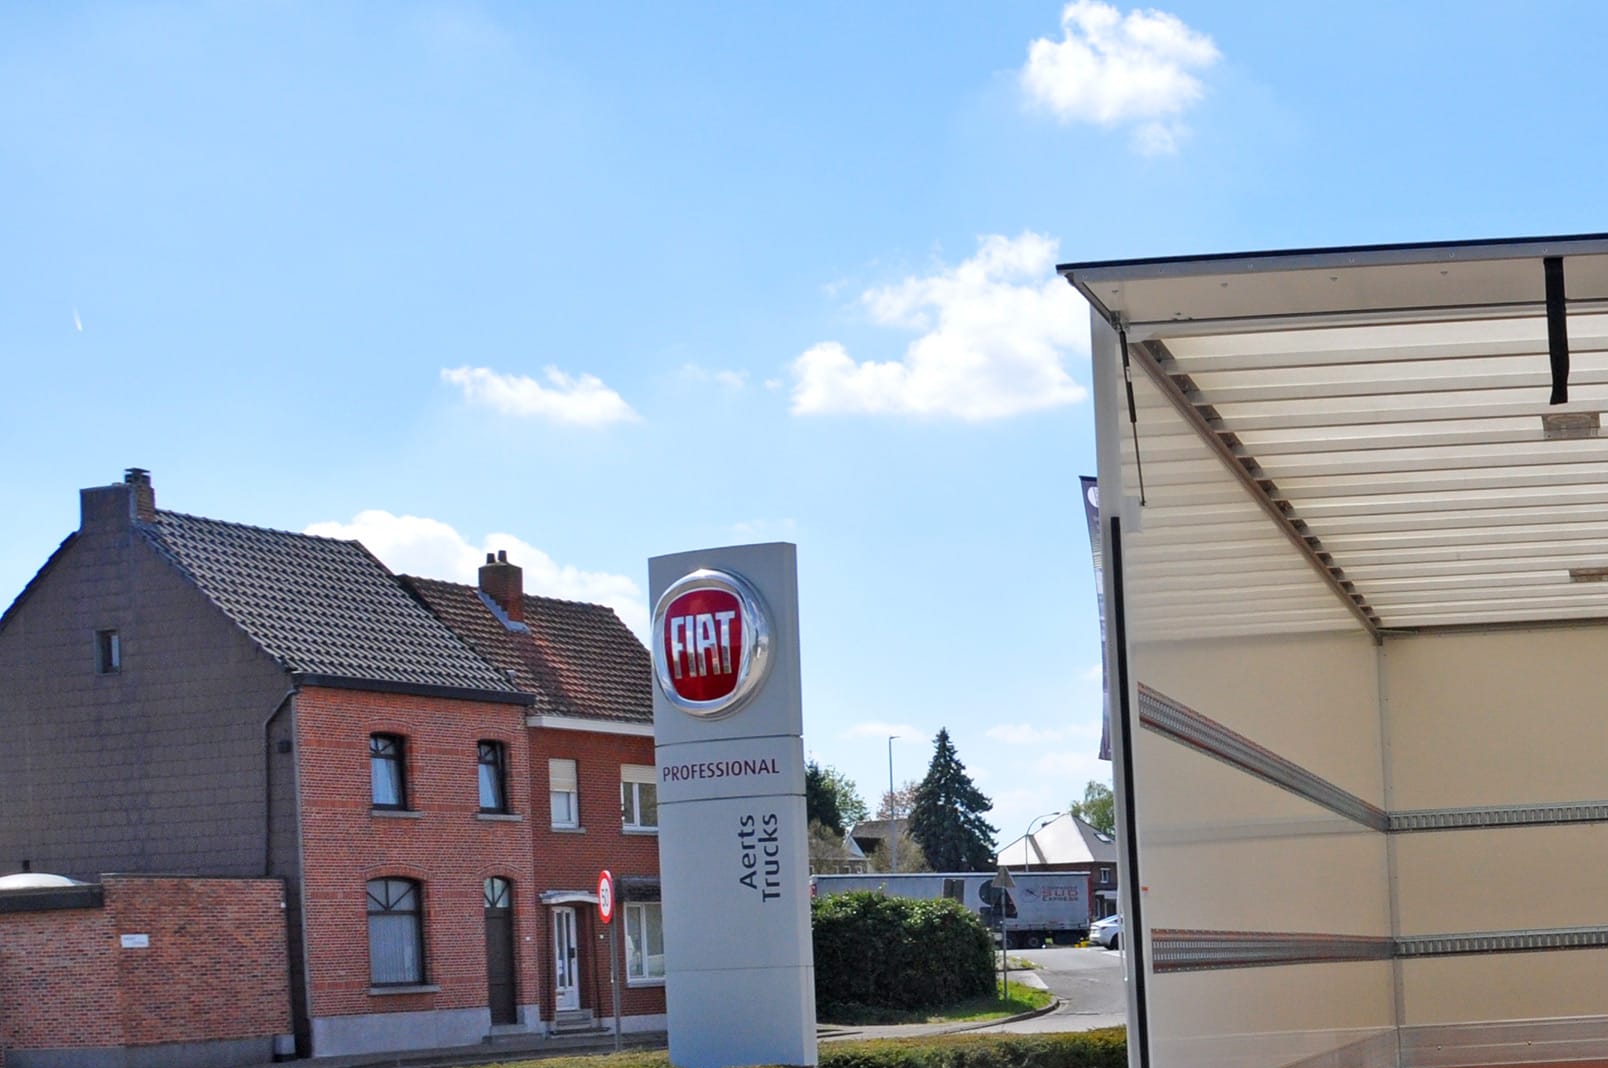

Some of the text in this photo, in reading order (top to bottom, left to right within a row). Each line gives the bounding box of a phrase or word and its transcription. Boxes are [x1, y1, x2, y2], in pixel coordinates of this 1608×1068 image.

[670, 610, 736, 680] FIAT
[662, 758, 780, 782] PROFESSIONAL
[737, 814, 758, 890] Aerts
[757, 813, 781, 903] Trucks
